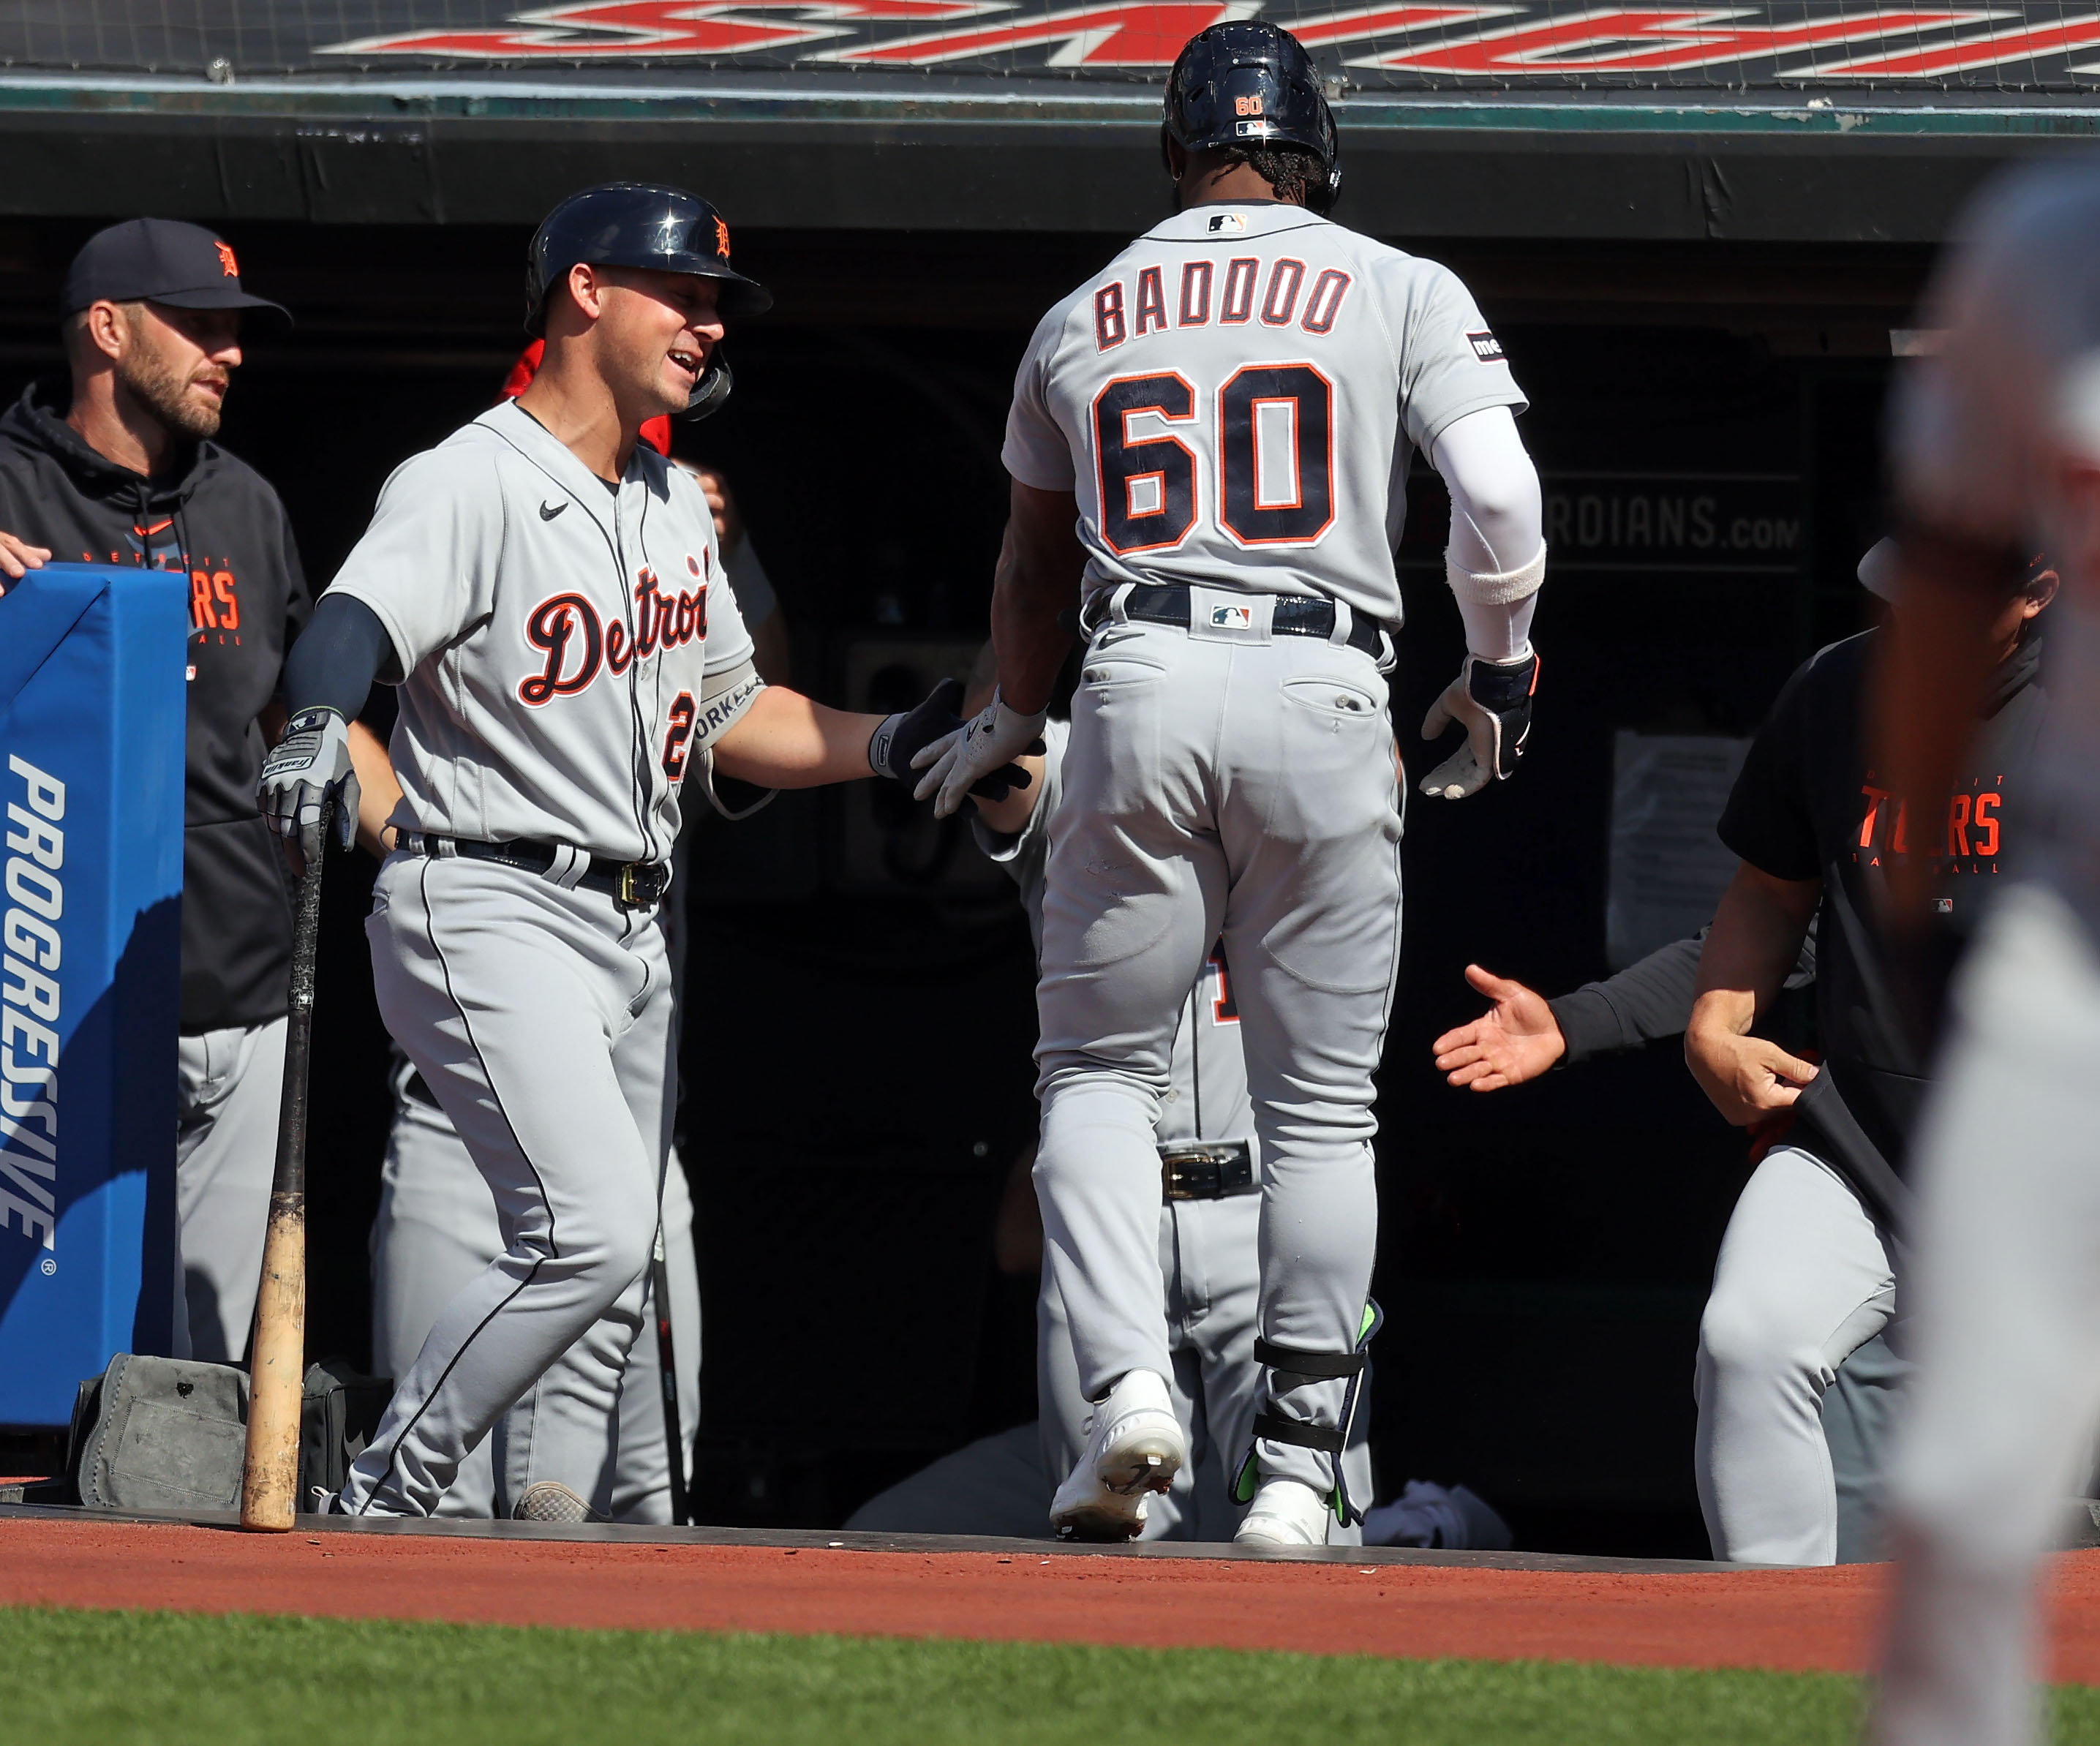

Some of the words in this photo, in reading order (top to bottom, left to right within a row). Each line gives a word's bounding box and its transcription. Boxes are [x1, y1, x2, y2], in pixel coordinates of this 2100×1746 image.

[1235, 97, 1263, 116] 60
[1094, 255, 1355, 355] BADDOO
[1472, 338, 1502, 355] me
[1091, 359, 1337, 559] 60
[1546, 494, 1799, 549] RDIANS.COM
